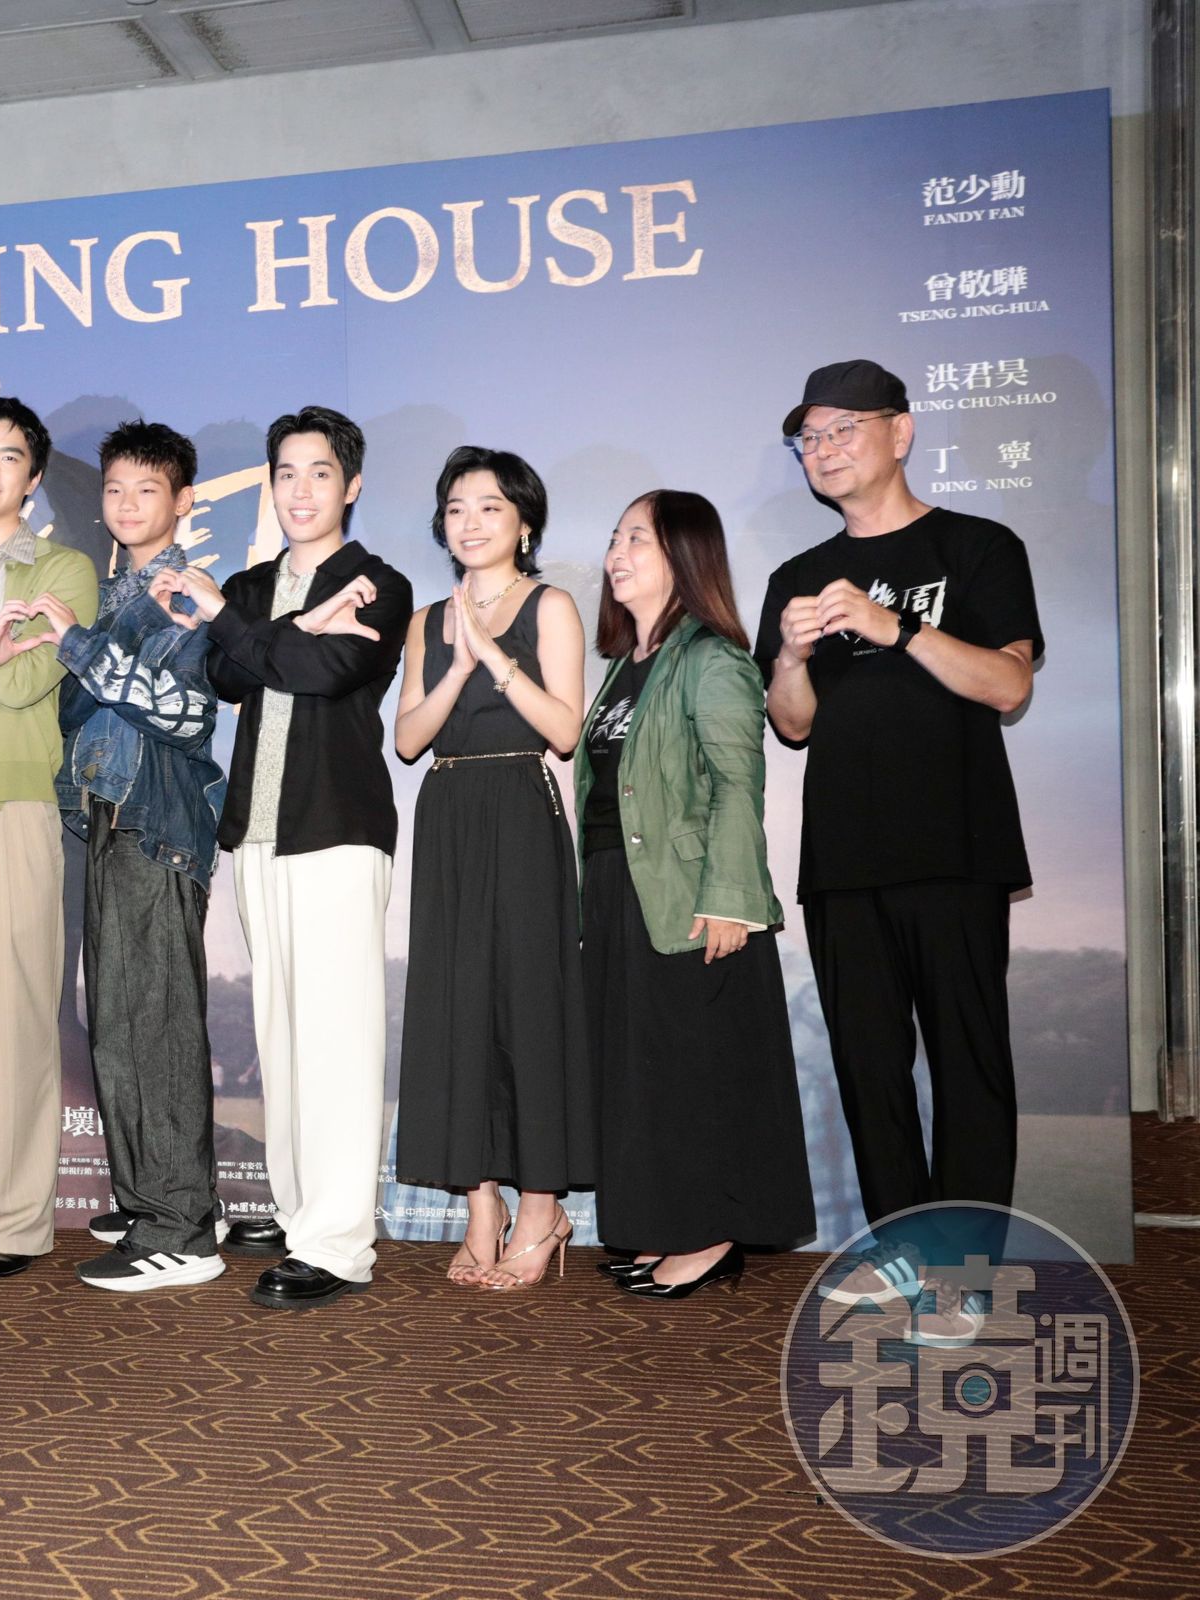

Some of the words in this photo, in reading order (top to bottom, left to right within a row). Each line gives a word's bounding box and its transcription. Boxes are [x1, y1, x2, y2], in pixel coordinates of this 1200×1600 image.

[921, 170, 1026, 207] 范少勳
[923, 210, 985, 226] FANDY
[988, 206, 1025, 220] FAN
[246, 179, 704, 313] HOUSE
[924, 266, 1028, 302] 曾敬驊
[899, 307, 957, 323] TSENG
[960, 300, 1050, 318] JING-HUA
[925, 358, 1029, 393] 洪君昊
[957, 392, 1057, 409] CHUN-HAO
[931, 480, 978, 493] DING
[985, 477, 1032, 490] NING
[227, 1201, 278, 1214] 桃園市政府
[395, 1206, 470, 1219] 臺中市政府新聞
